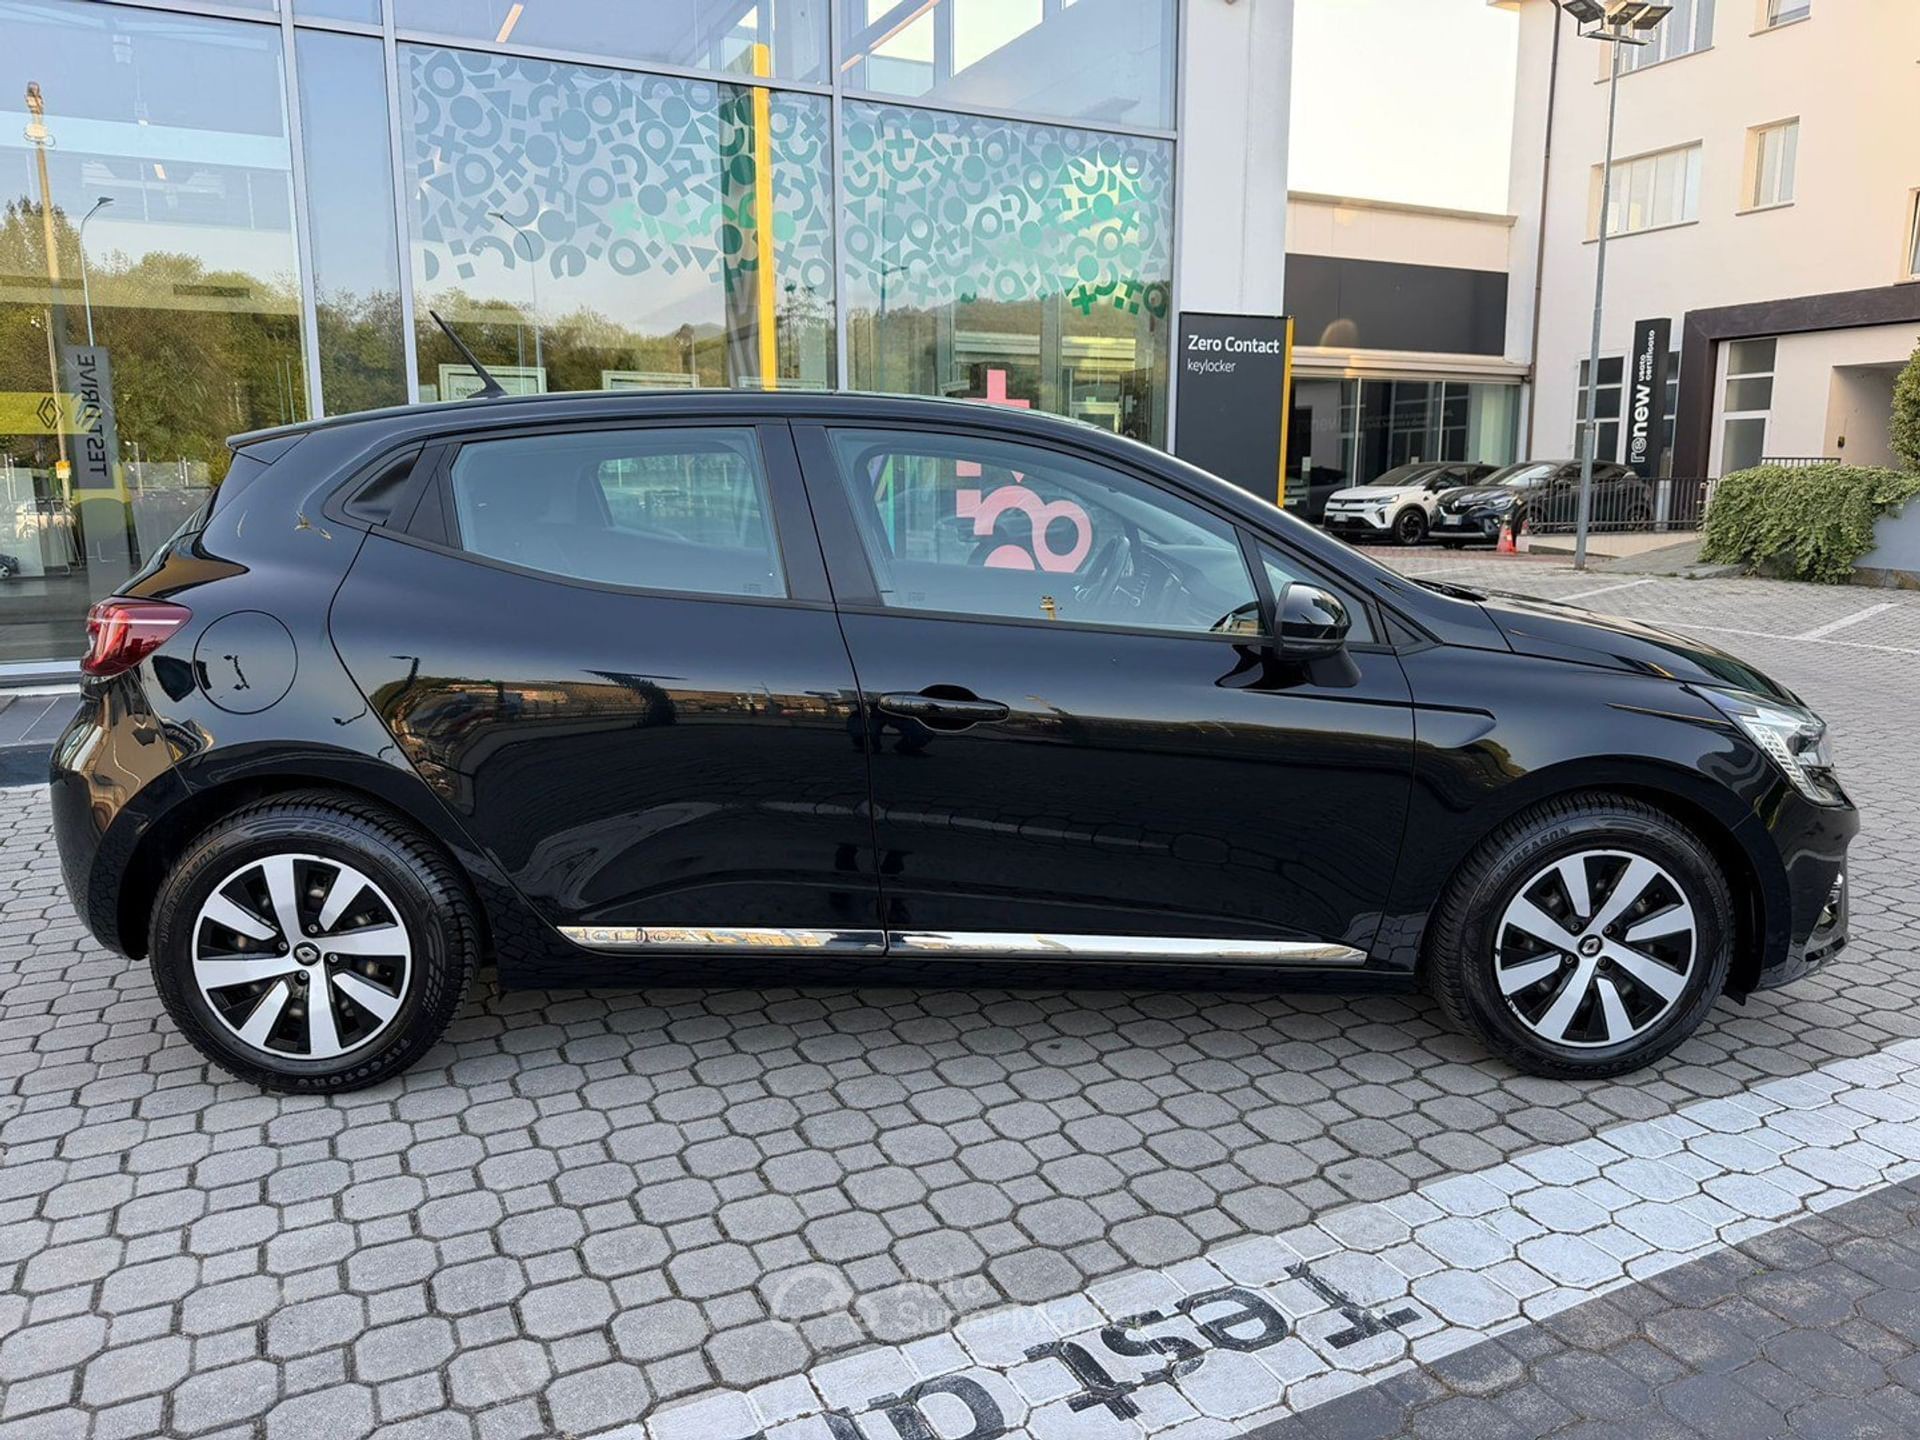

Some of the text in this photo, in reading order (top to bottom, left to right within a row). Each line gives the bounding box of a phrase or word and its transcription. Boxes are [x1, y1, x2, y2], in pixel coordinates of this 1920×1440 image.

[1187, 334, 1280, 354] Zero Contact
[1645, 329, 1656, 381] certificato
[1186, 358, 1236, 375] keylocker
[1638, 353, 1647, 382] usato
[1630, 384, 1651, 463] renew
